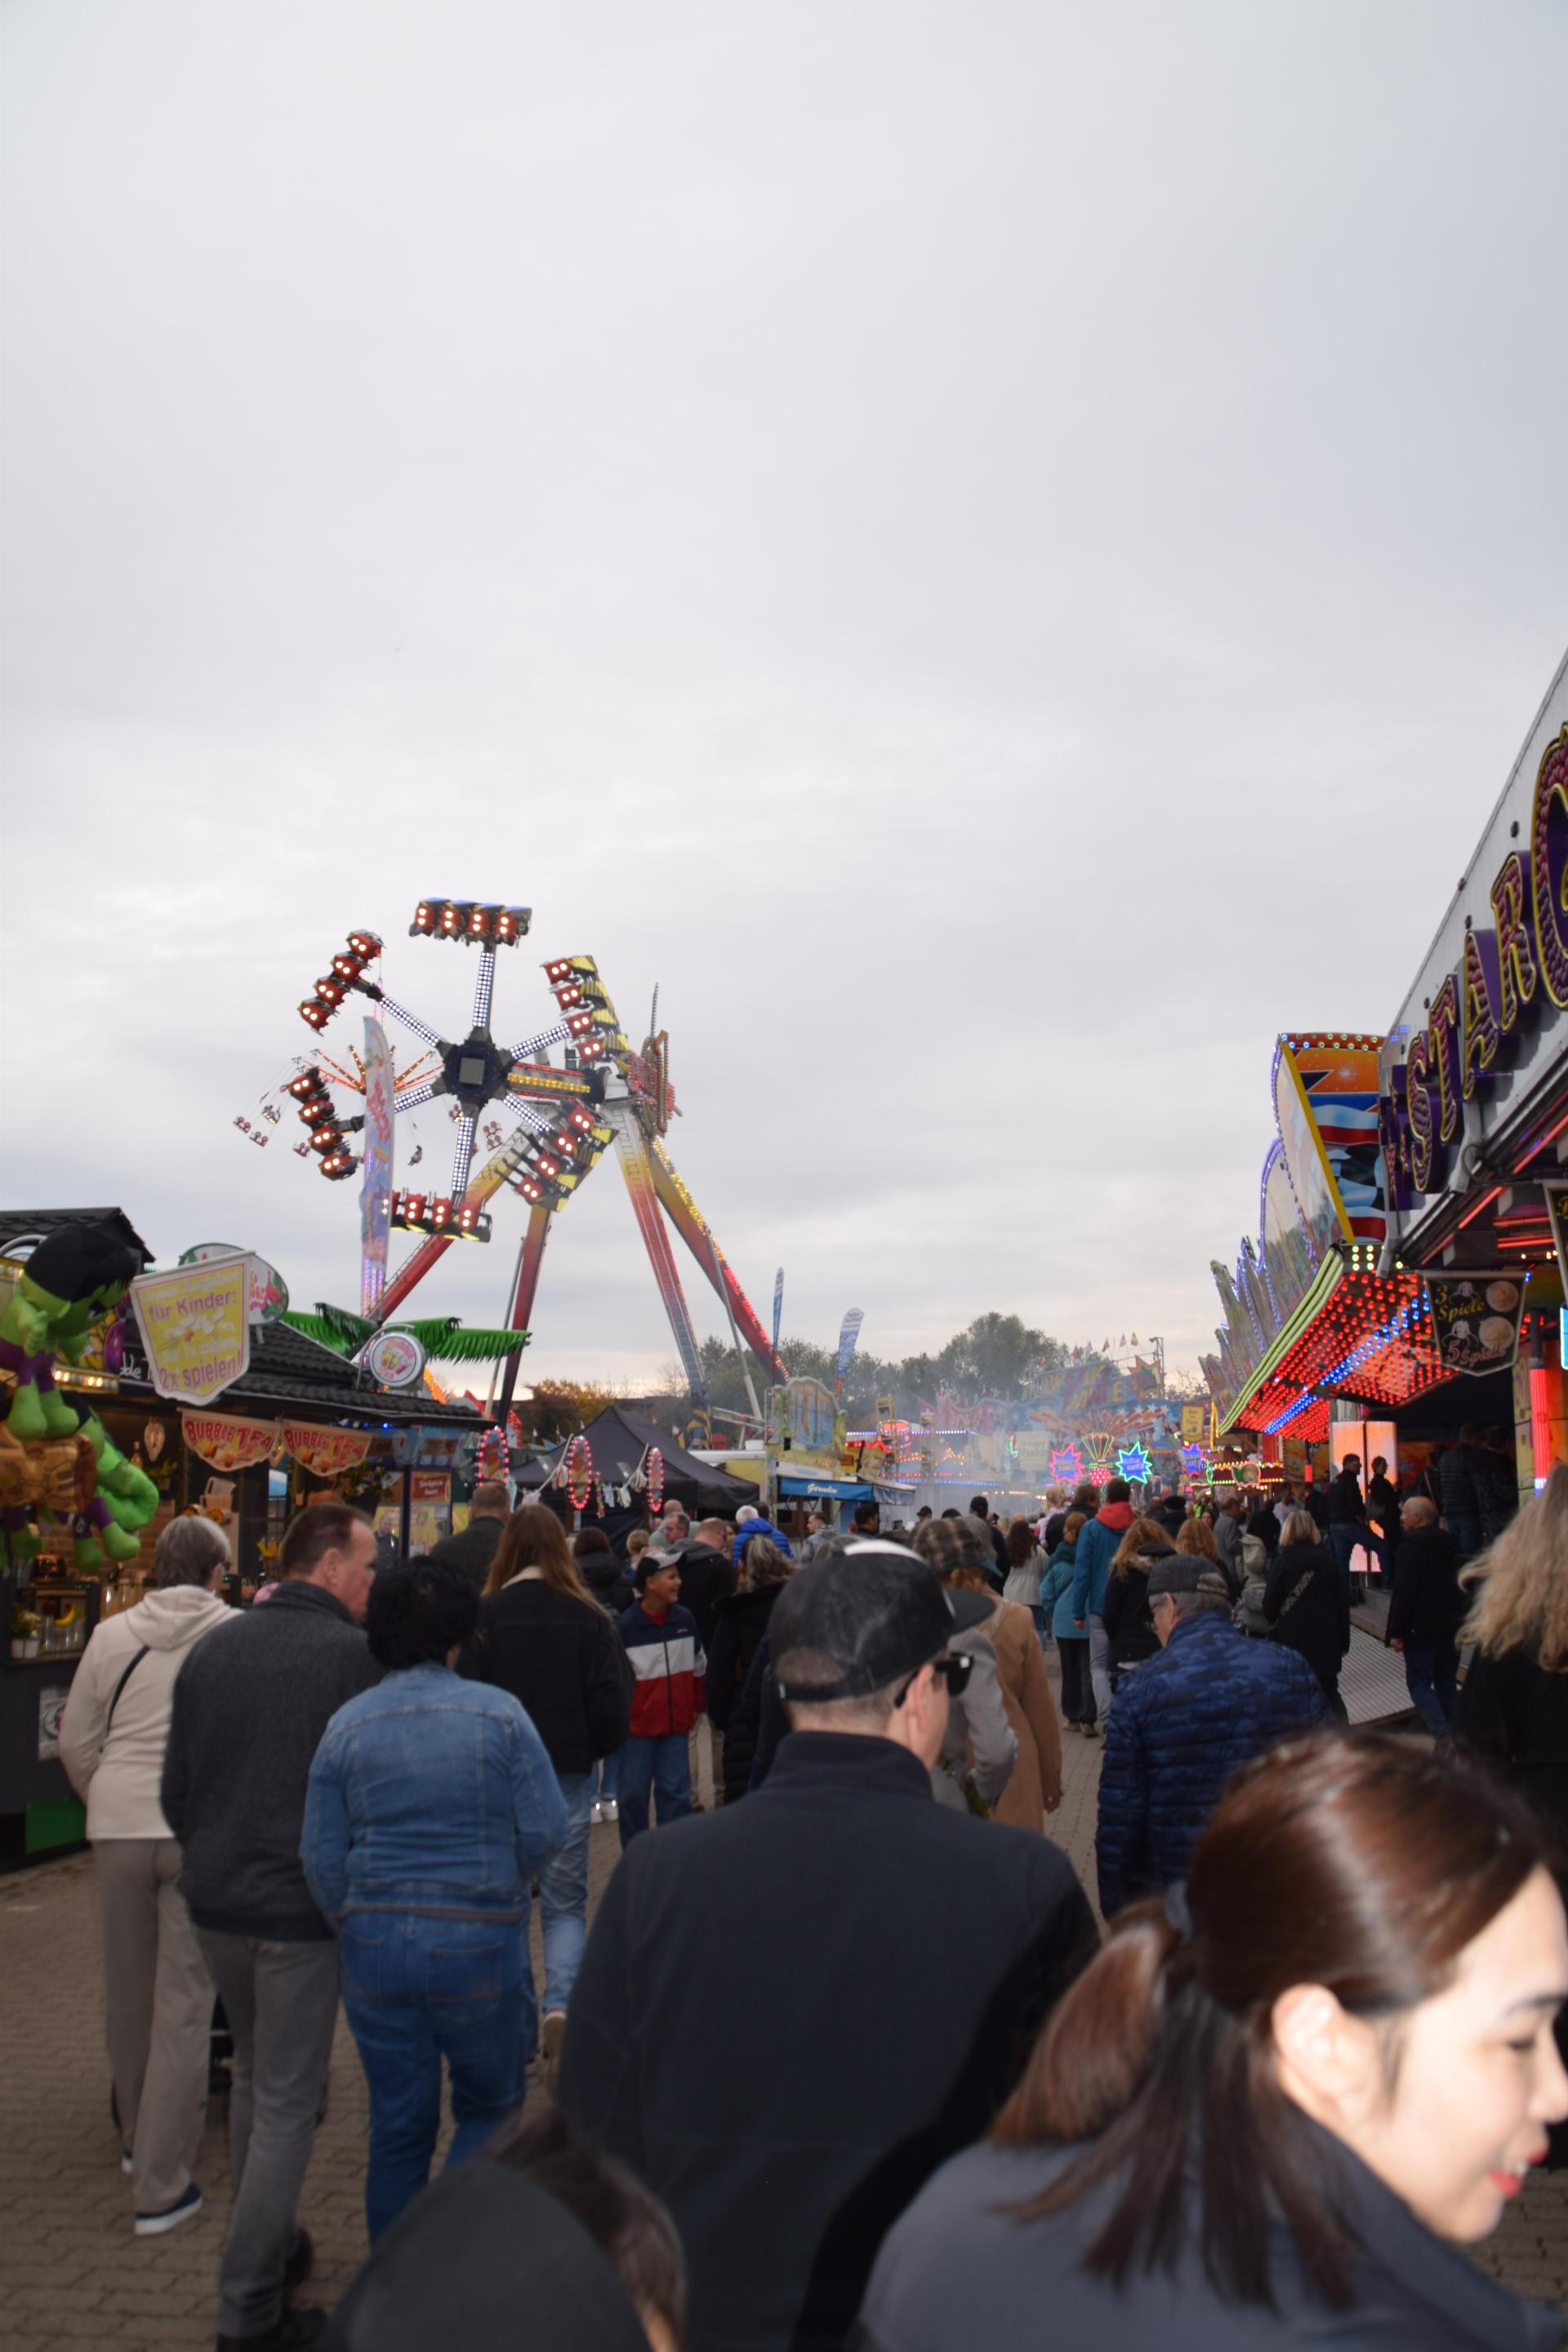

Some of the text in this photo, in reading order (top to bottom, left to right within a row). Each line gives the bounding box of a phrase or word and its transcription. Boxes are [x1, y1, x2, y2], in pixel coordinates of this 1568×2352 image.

[1435, 1285, 1448, 1304] 3
[149, 1304, 171, 1322] für
[1446, 1339, 1460, 1362] 5
[185, 1420, 274, 1451] BUBBLE TEA
[283, 1428, 329, 1450] BUBBLE
